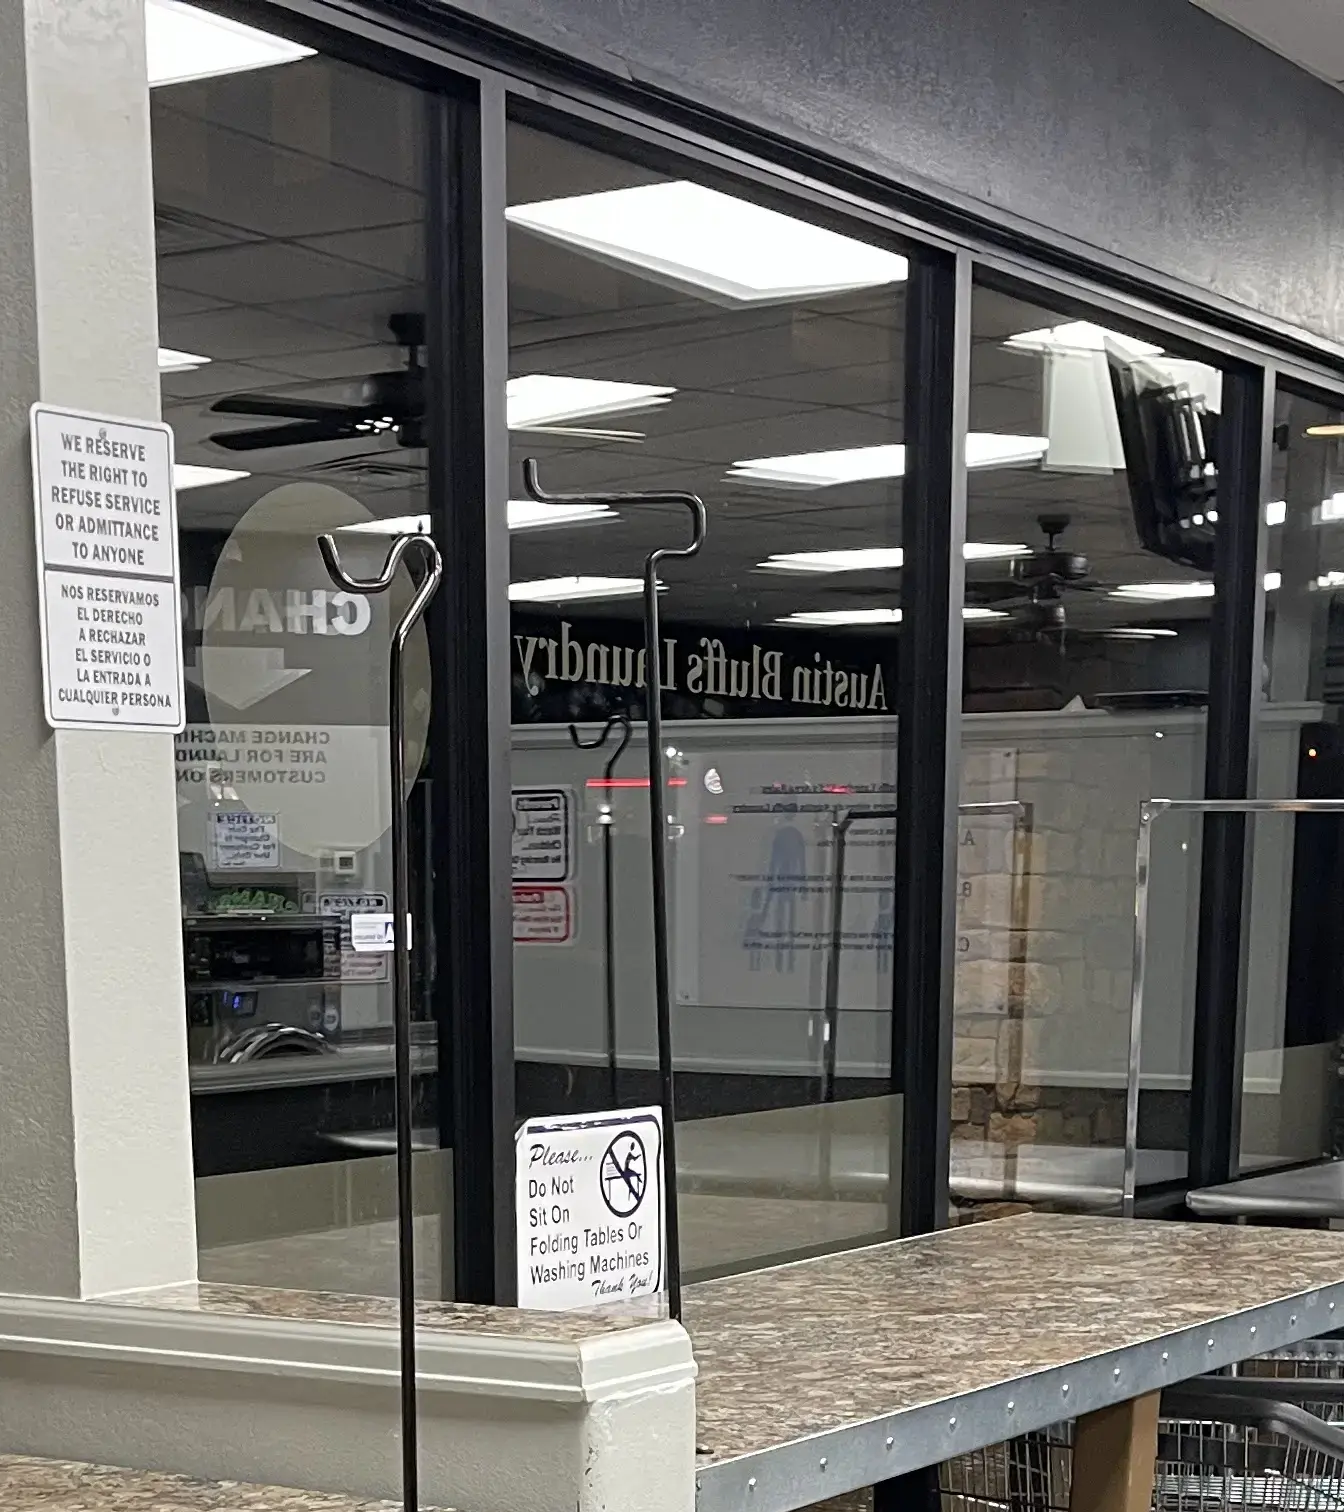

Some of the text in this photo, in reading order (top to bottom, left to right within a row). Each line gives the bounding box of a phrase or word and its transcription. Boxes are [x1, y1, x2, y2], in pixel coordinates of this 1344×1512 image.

[61, 433, 145, 461] WE RESERVE
[61, 460, 147, 487] THE RIGHT TO
[52, 486, 160, 515] REFUSE SERVICE
[56, 513, 159, 541] OR ADMITTANCE
[72, 542, 144, 565] TO ANYONE
[61, 584, 159, 606] NOS RESERVAMOS
[78, 607, 143, 625] EL DERECHO
[79, 628, 146, 646] A RECHAZAR
[76, 648, 151, 666] EL SERVICIO O
[77, 668, 151, 687] LA ENTRADA A
[58, 688, 171, 708] CUALQUIER PERSONA
[529, 1143, 593, 1169] Please...
[529, 1176, 574, 1198] Do Not
[529, 1205, 570, 1228] Sit On
[531, 1221, 643, 1256] Folding Tables Or
[530, 1249, 649, 1285] Washing Machines
[591, 1270, 654, 1297] Thank You!
